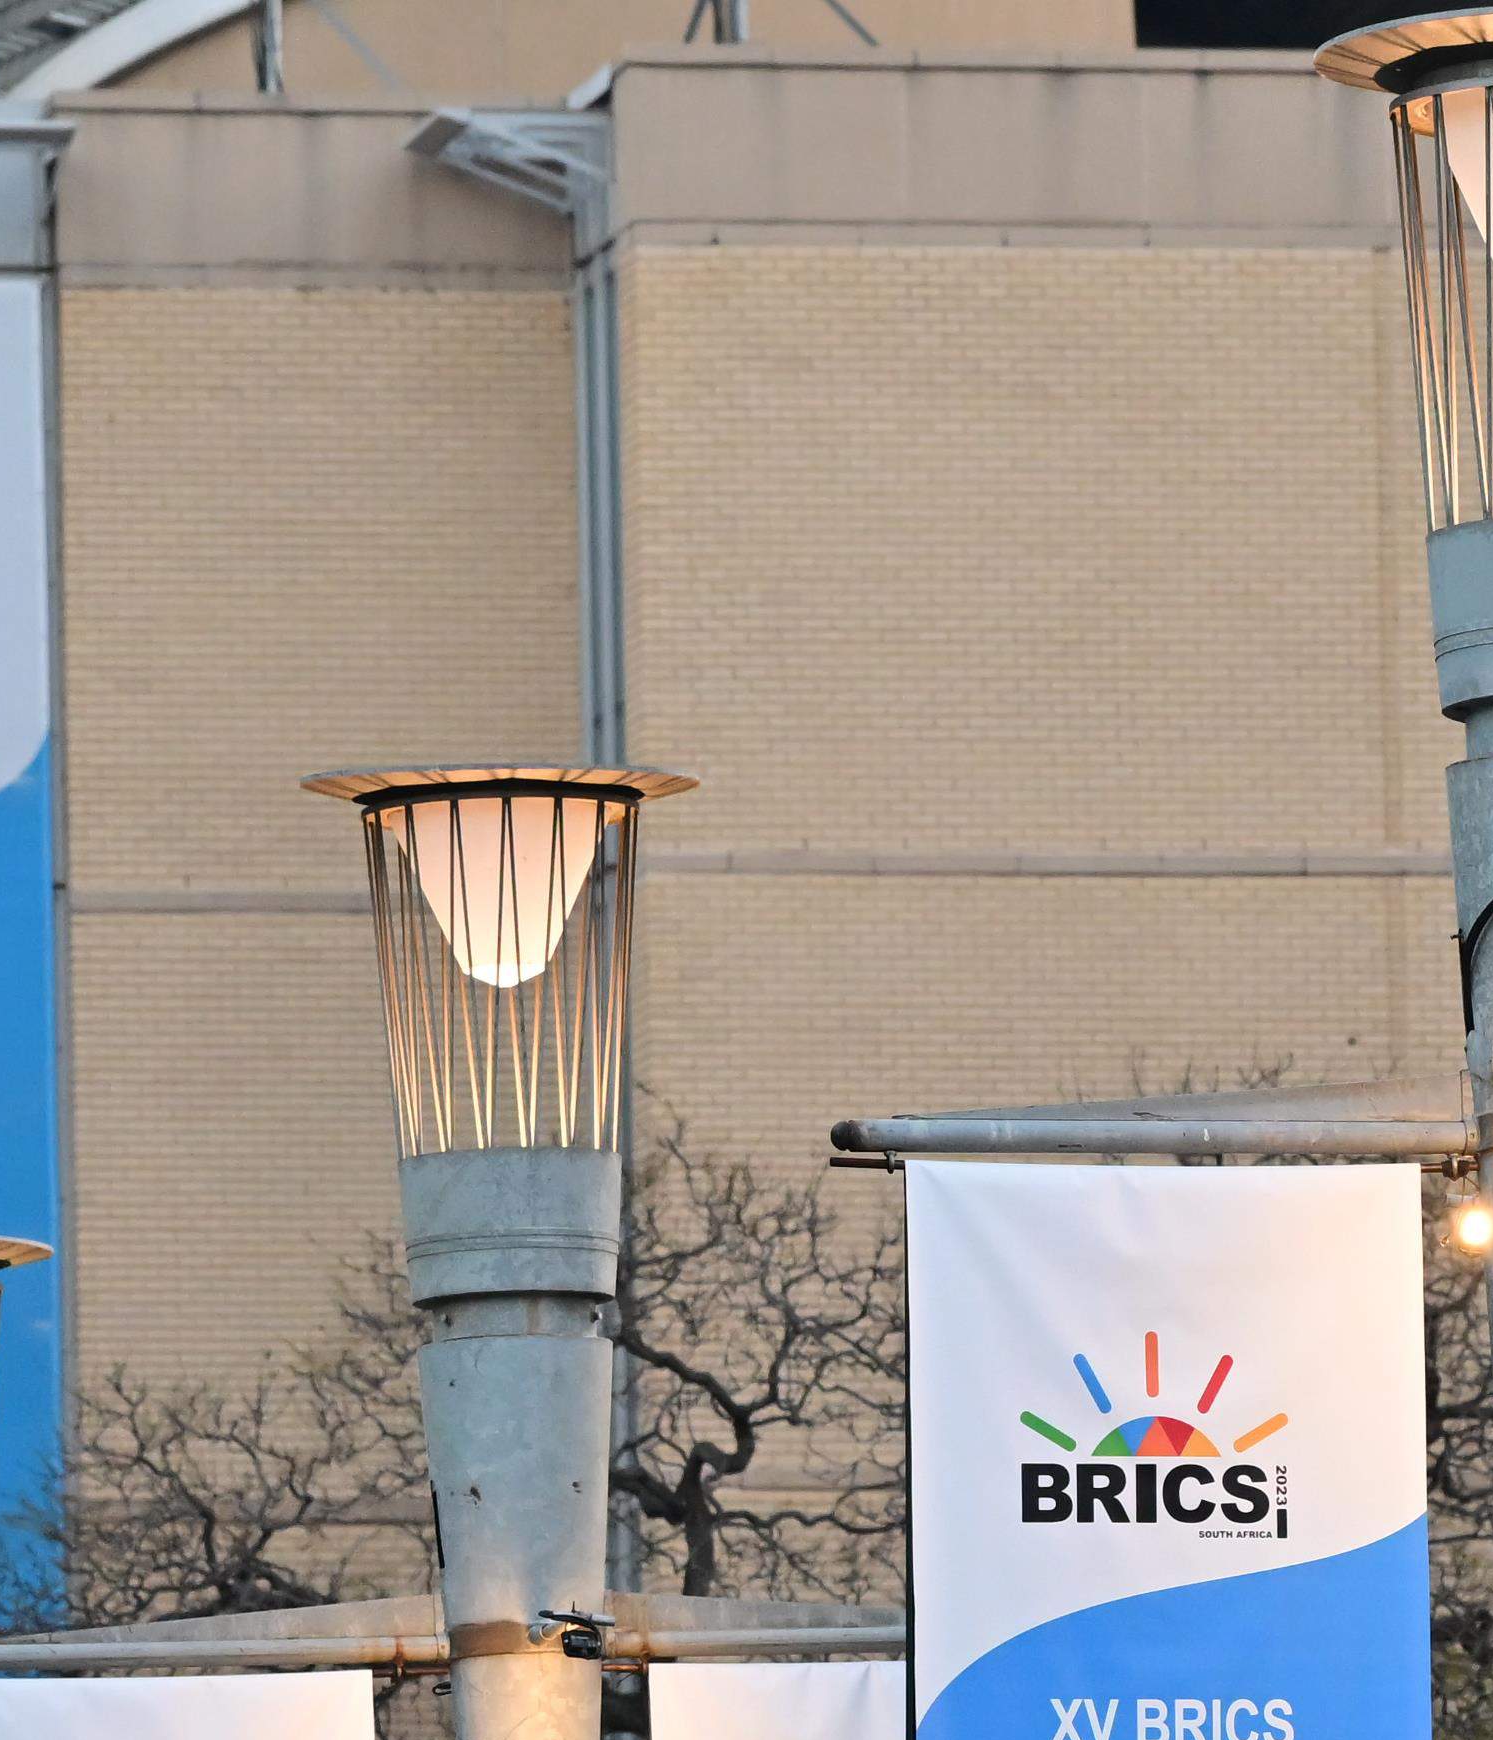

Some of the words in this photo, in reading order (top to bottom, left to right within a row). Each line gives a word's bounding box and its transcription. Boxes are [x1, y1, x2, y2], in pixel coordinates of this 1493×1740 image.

[1021, 1463, 1270, 1524] BRICS
[1275, 1465, 1288, 1506] 2023
[1198, 1530, 1233, 1539] SOUTH
[1236, 1530, 1273, 1539] AFRICA
